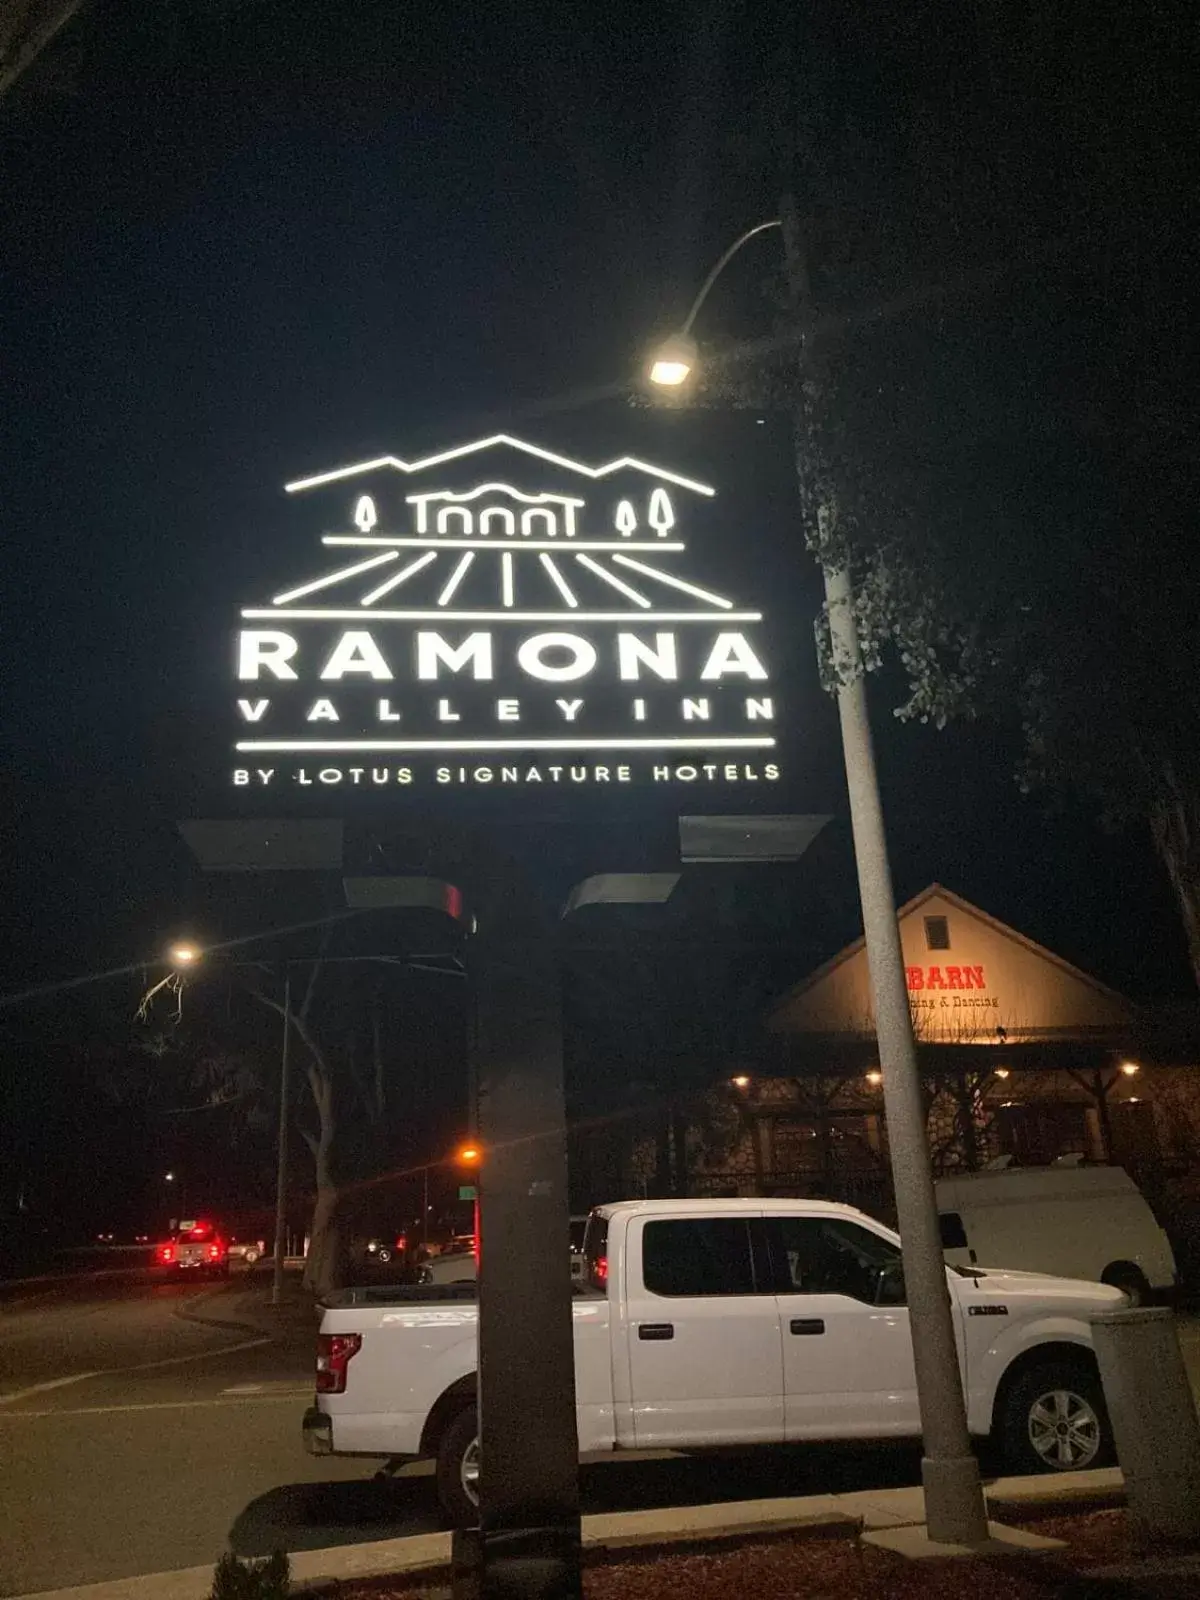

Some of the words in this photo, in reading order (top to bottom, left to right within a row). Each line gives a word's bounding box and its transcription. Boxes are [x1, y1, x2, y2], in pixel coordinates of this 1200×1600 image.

[238, 631, 769, 681] RAMONA
[238, 700, 583, 721] VALLEY
[635, 698, 774, 720] INN
[233, 769, 275, 786] BY
[298, 768, 413, 785] LOTUS
[436, 766, 632, 783] SIGNATURE
[653, 764, 781, 781] HOTELS
[906, 965, 986, 990] BARN
[910, 998, 936, 1009] ning
[940, 996, 949, 1008] &
[952, 996, 1000, 1009] Dancing
